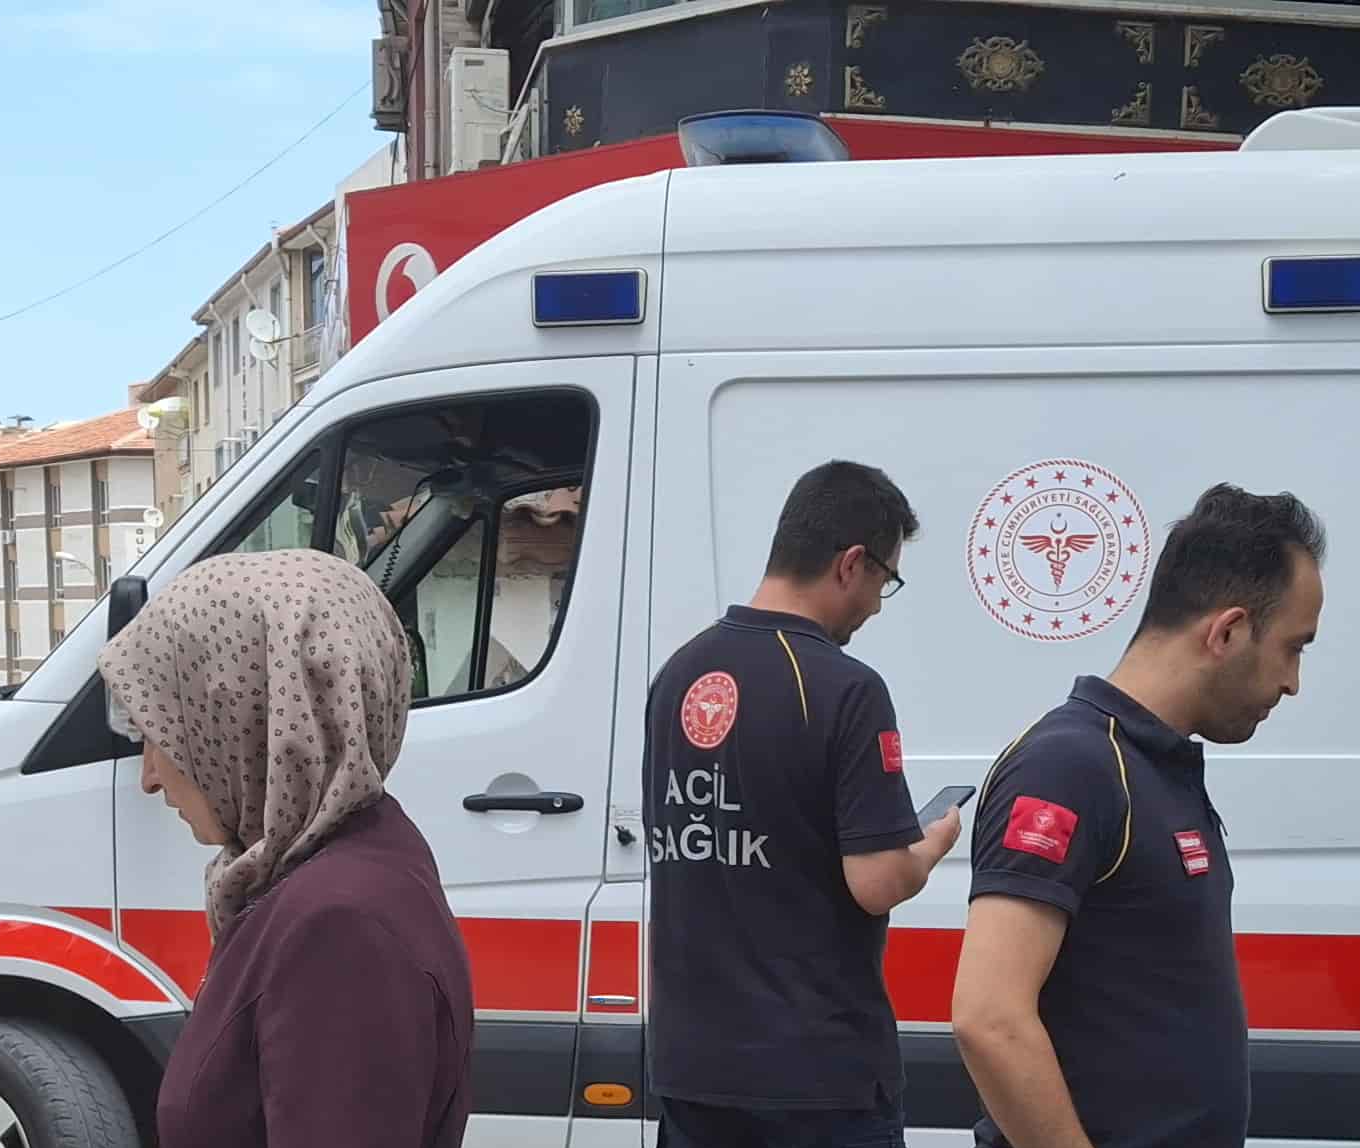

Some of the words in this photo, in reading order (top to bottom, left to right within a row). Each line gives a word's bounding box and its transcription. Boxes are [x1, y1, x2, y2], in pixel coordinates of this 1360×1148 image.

[1001, 492, 1071, 547] CUMHURİYETİ
[1074, 494, 1113, 530] SAĞLIK
[1083, 529, 1117, 599] BAKANLIĞI
[664, 762, 741, 811] ACİL
[651, 813, 772, 869] SAĞLIK
